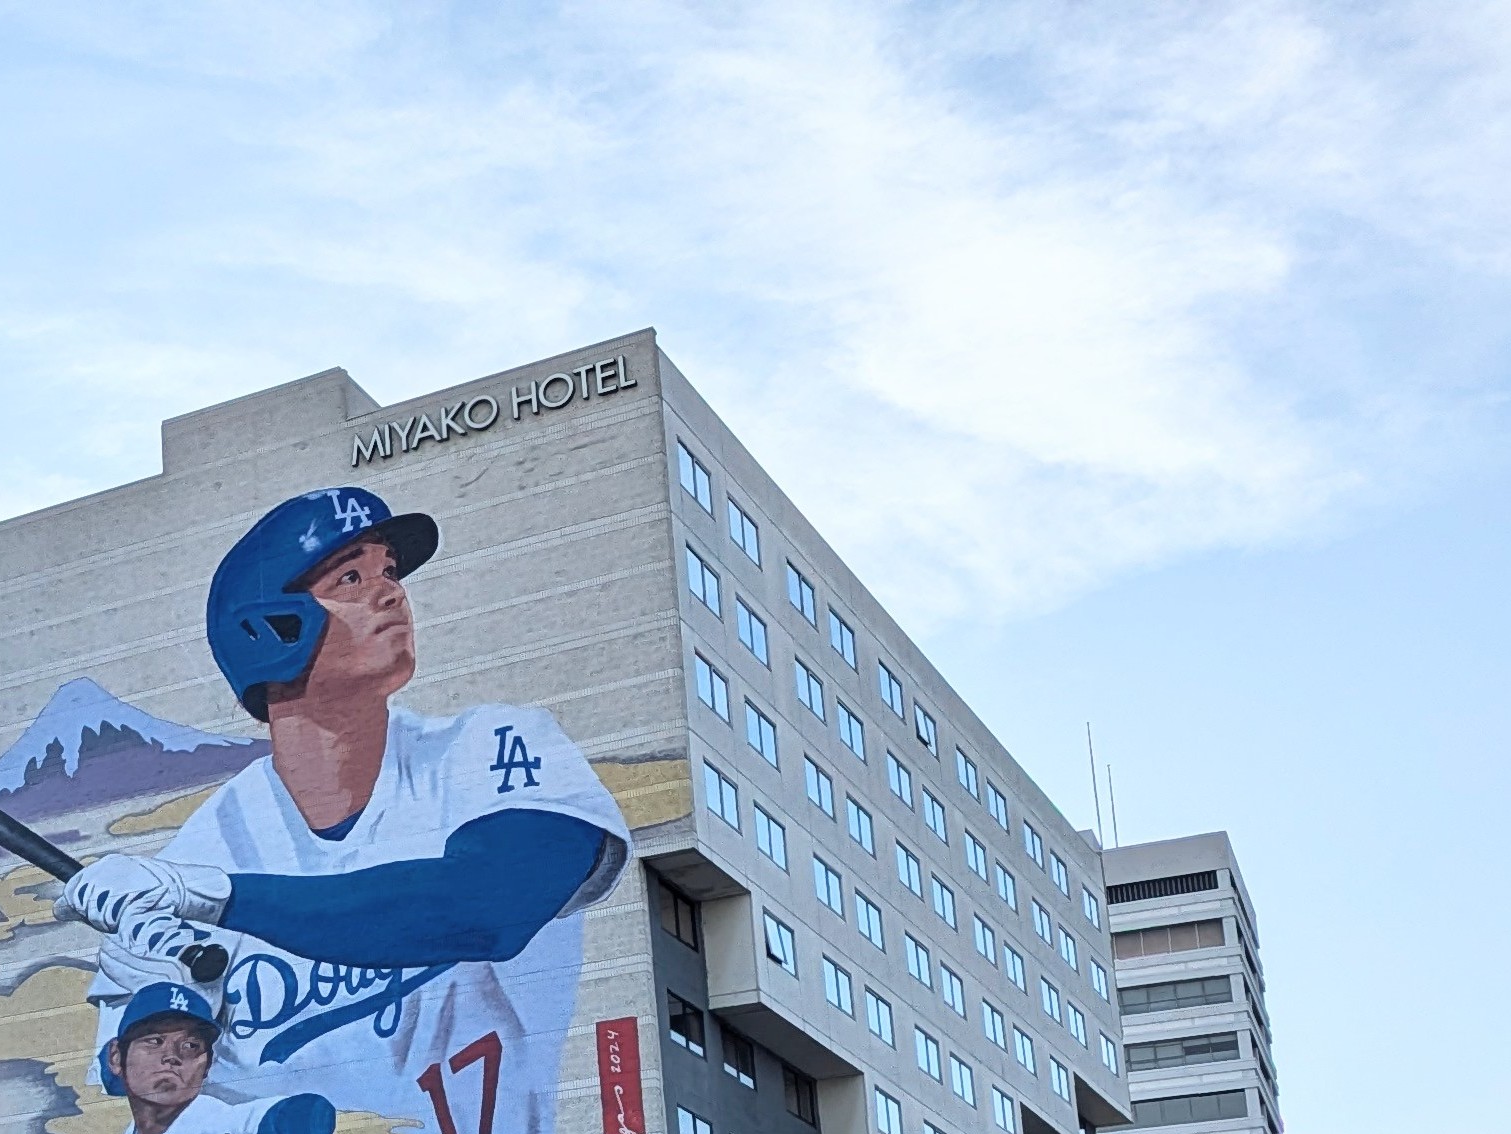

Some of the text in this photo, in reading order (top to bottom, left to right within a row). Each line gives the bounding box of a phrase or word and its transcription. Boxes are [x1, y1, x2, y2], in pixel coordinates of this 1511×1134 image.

[351, 355, 637, 467] MIYAKO HOTEL
[327, 490, 373, 532] LA
[490, 725, 541, 794] LA
[170, 987, 189, 1011] LA
[607, 1030, 622, 1073] 2024
